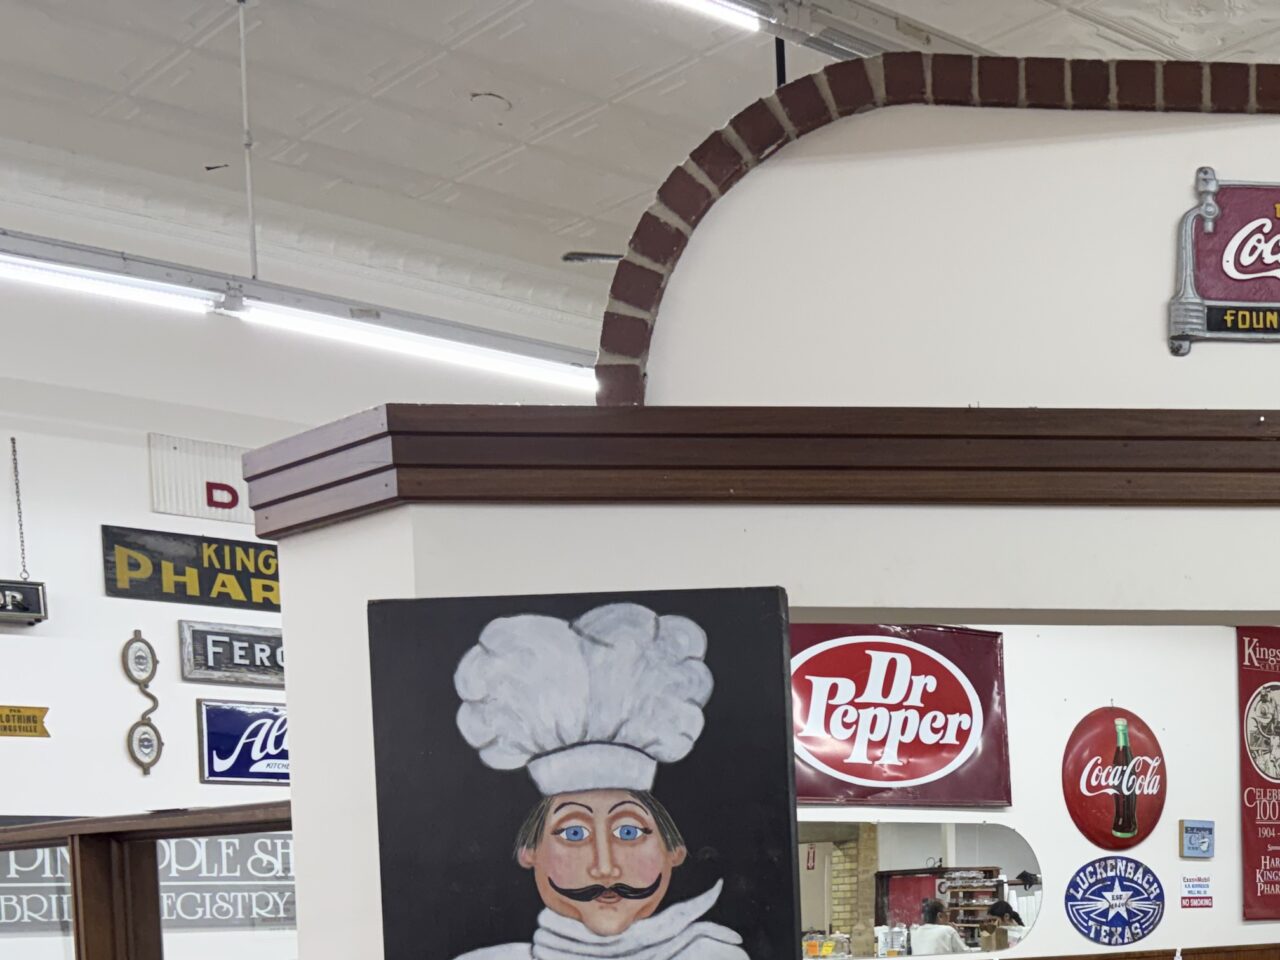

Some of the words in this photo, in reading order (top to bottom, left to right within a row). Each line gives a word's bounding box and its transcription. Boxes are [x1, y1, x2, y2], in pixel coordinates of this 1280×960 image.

[114, 544, 280, 605] PHAR
[202, 543, 278, 575] KING
[854, 650, 937, 707] Dr
[797, 675, 972, 766] Pepper
[1079, 756, 1161, 797] Coca-Cola
[1256, 800, 1279, 820] 100
[1258, 828, 1275, 838] 1904
[1069, 858, 1160, 900] LUCKENBACH
[1088, 919, 1143, 945] TEXAS
